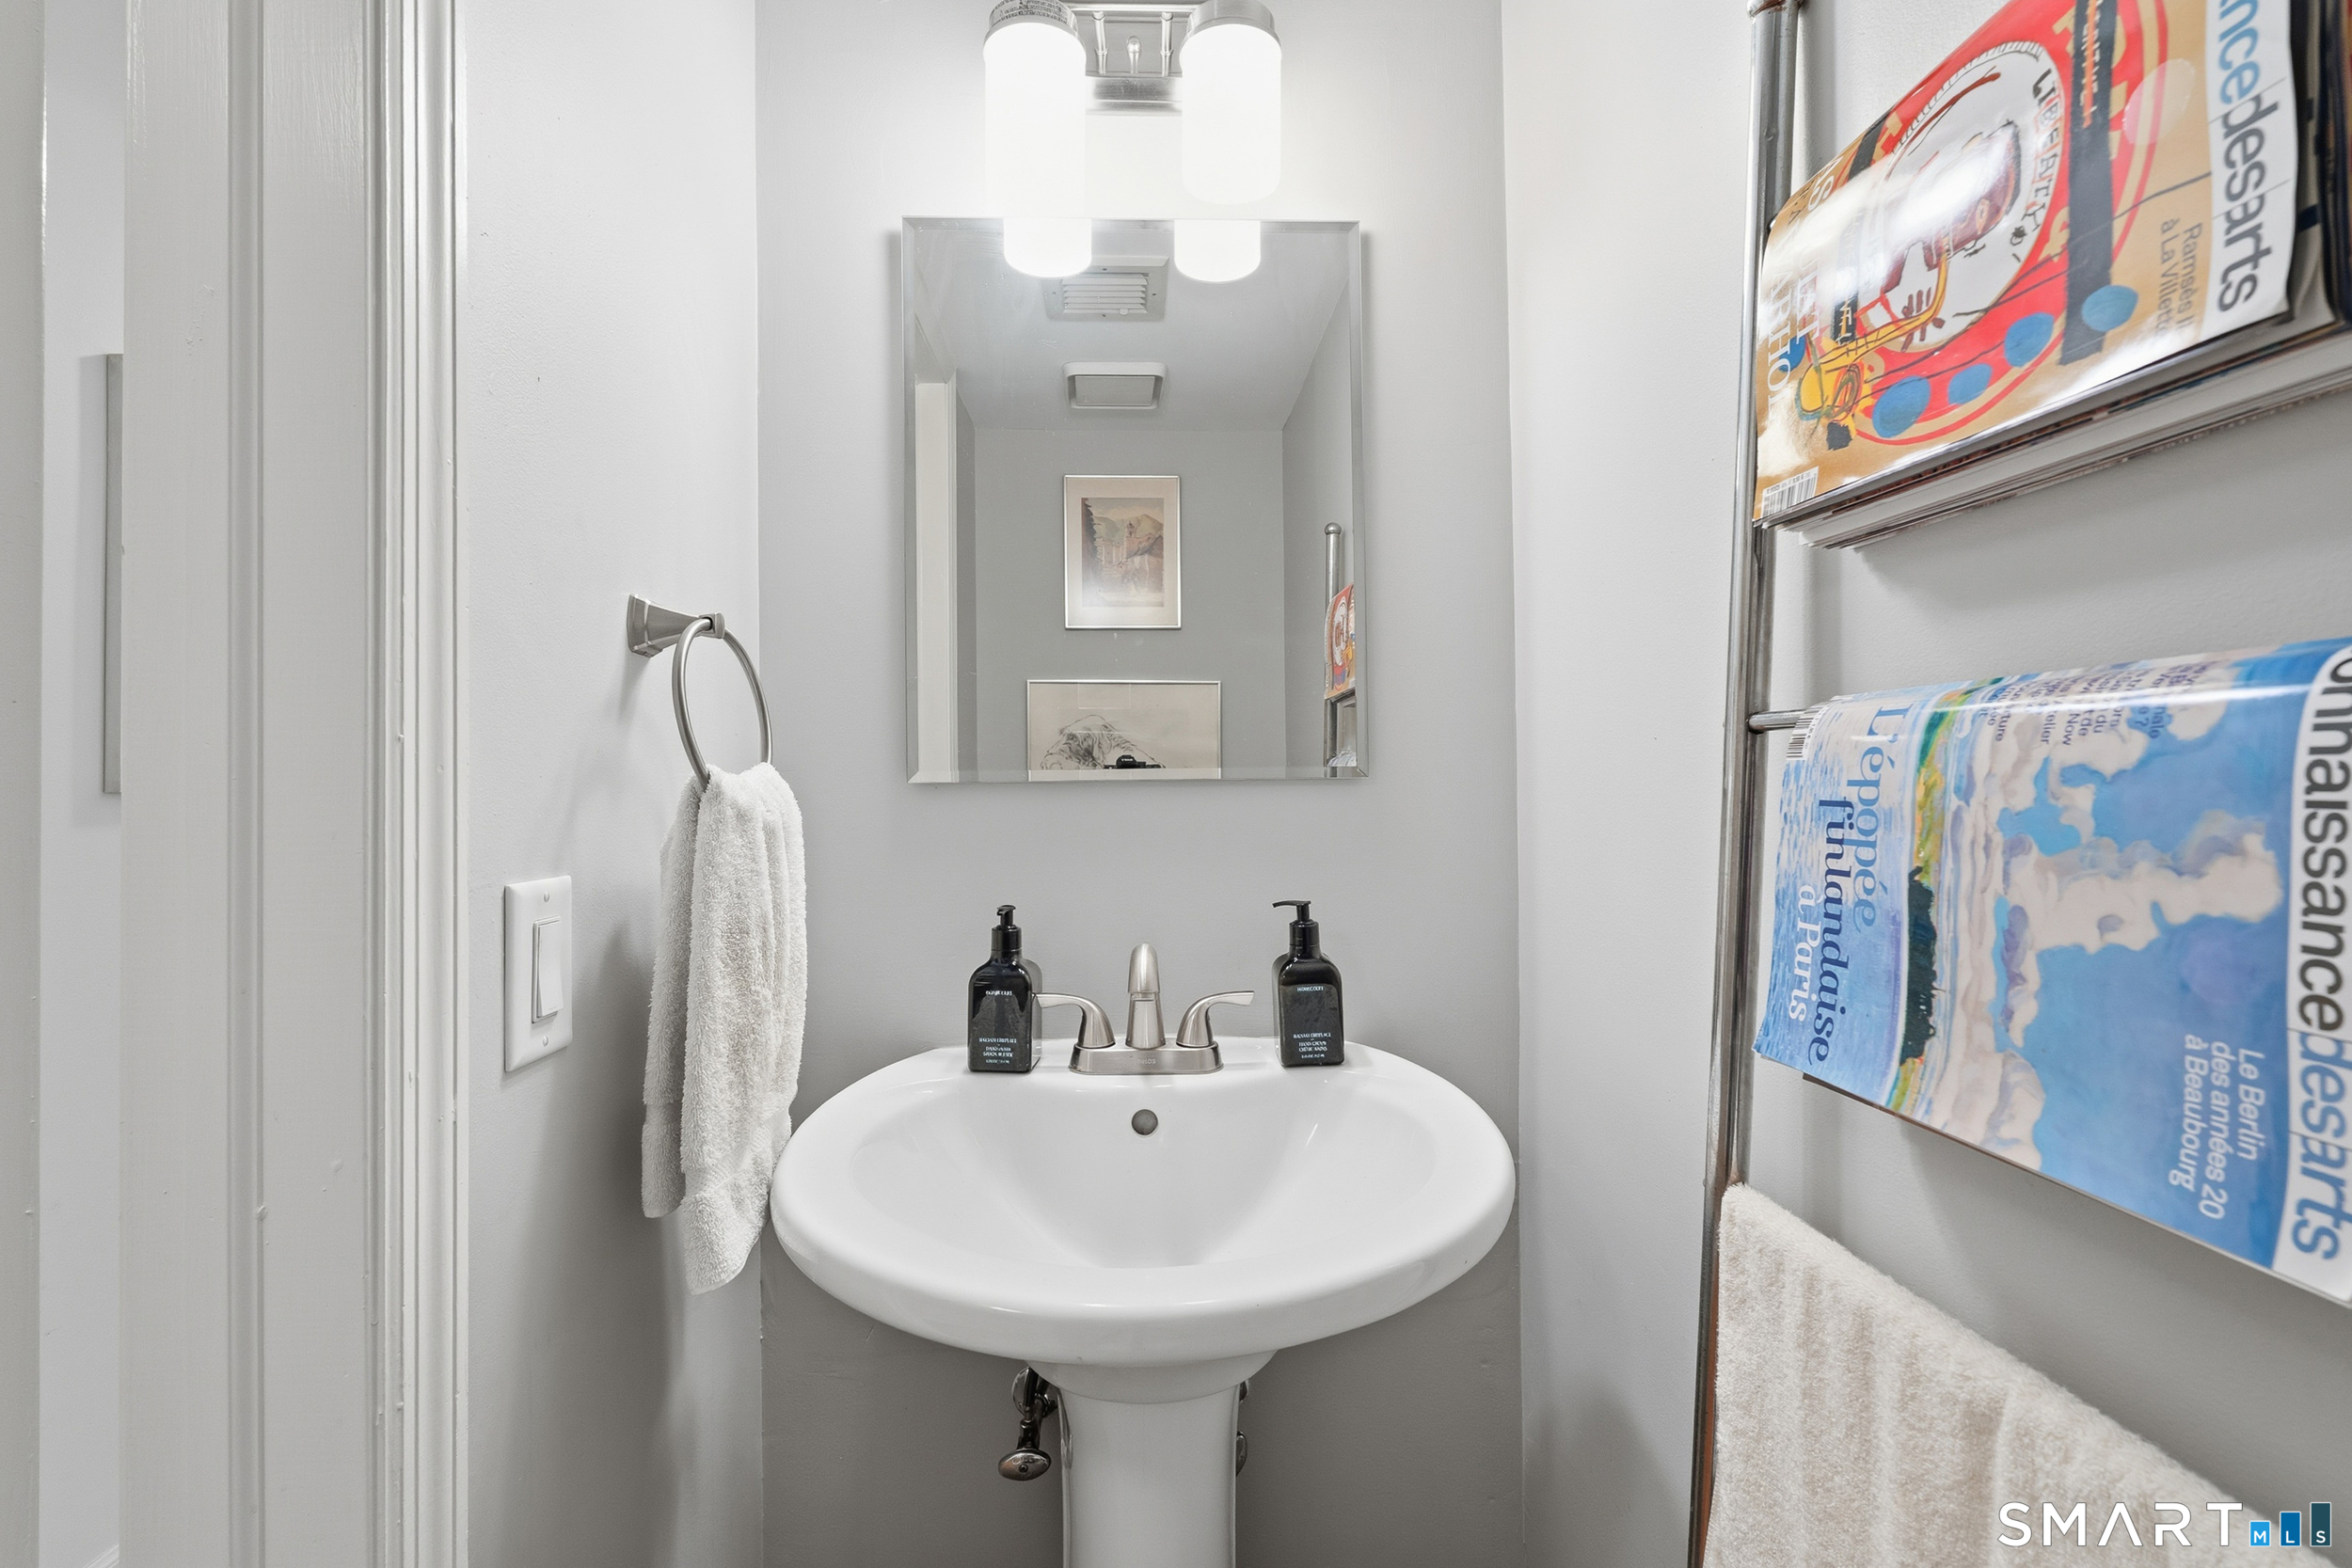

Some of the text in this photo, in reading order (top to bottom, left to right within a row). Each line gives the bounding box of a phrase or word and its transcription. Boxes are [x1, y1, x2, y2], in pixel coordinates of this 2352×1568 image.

[2161, 217, 2181, 234] à
[2161, 234, 2181, 263] La
[2176, 222, 2203, 313] Ramsès
[2062, 713, 2081, 746] Now
[2093, 715, 2107, 734] du
[1788, 884, 1823, 1022] à Paris
[1808, 797, 1853, 1066] finlandaise
[2169, 1033, 2209, 1193] à Beaubourg
[2199, 1041, 2235, 1221] des années 20
[2236, 1047, 2266, 1162] Le Berlin
